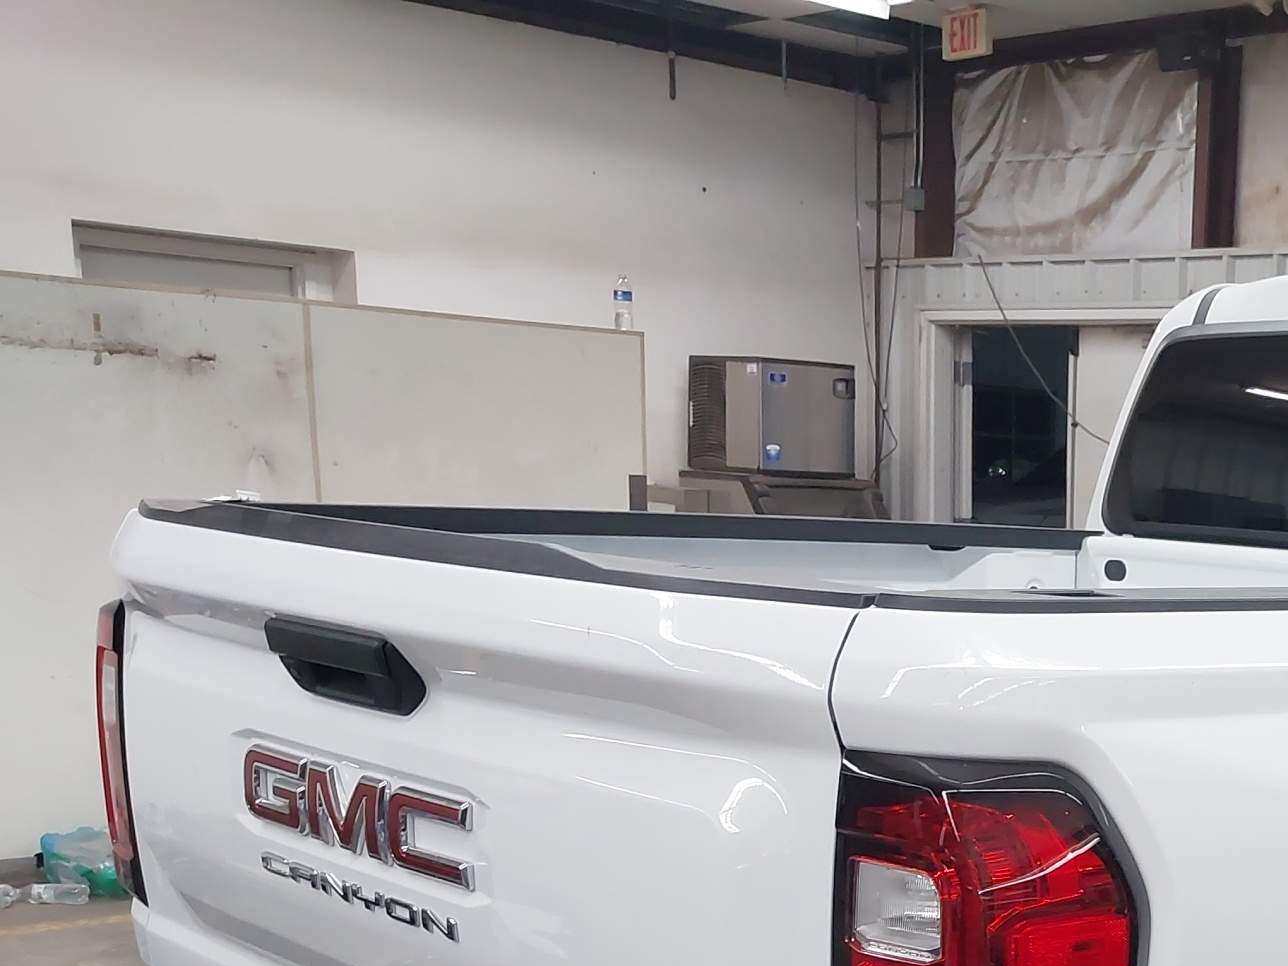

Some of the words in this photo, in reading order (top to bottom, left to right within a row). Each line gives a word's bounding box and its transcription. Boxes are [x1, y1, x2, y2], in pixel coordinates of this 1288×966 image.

[949, 14, 977, 53] EXIT
[244, 744, 476, 893] GMC
[261, 851, 460, 943] CANYON
